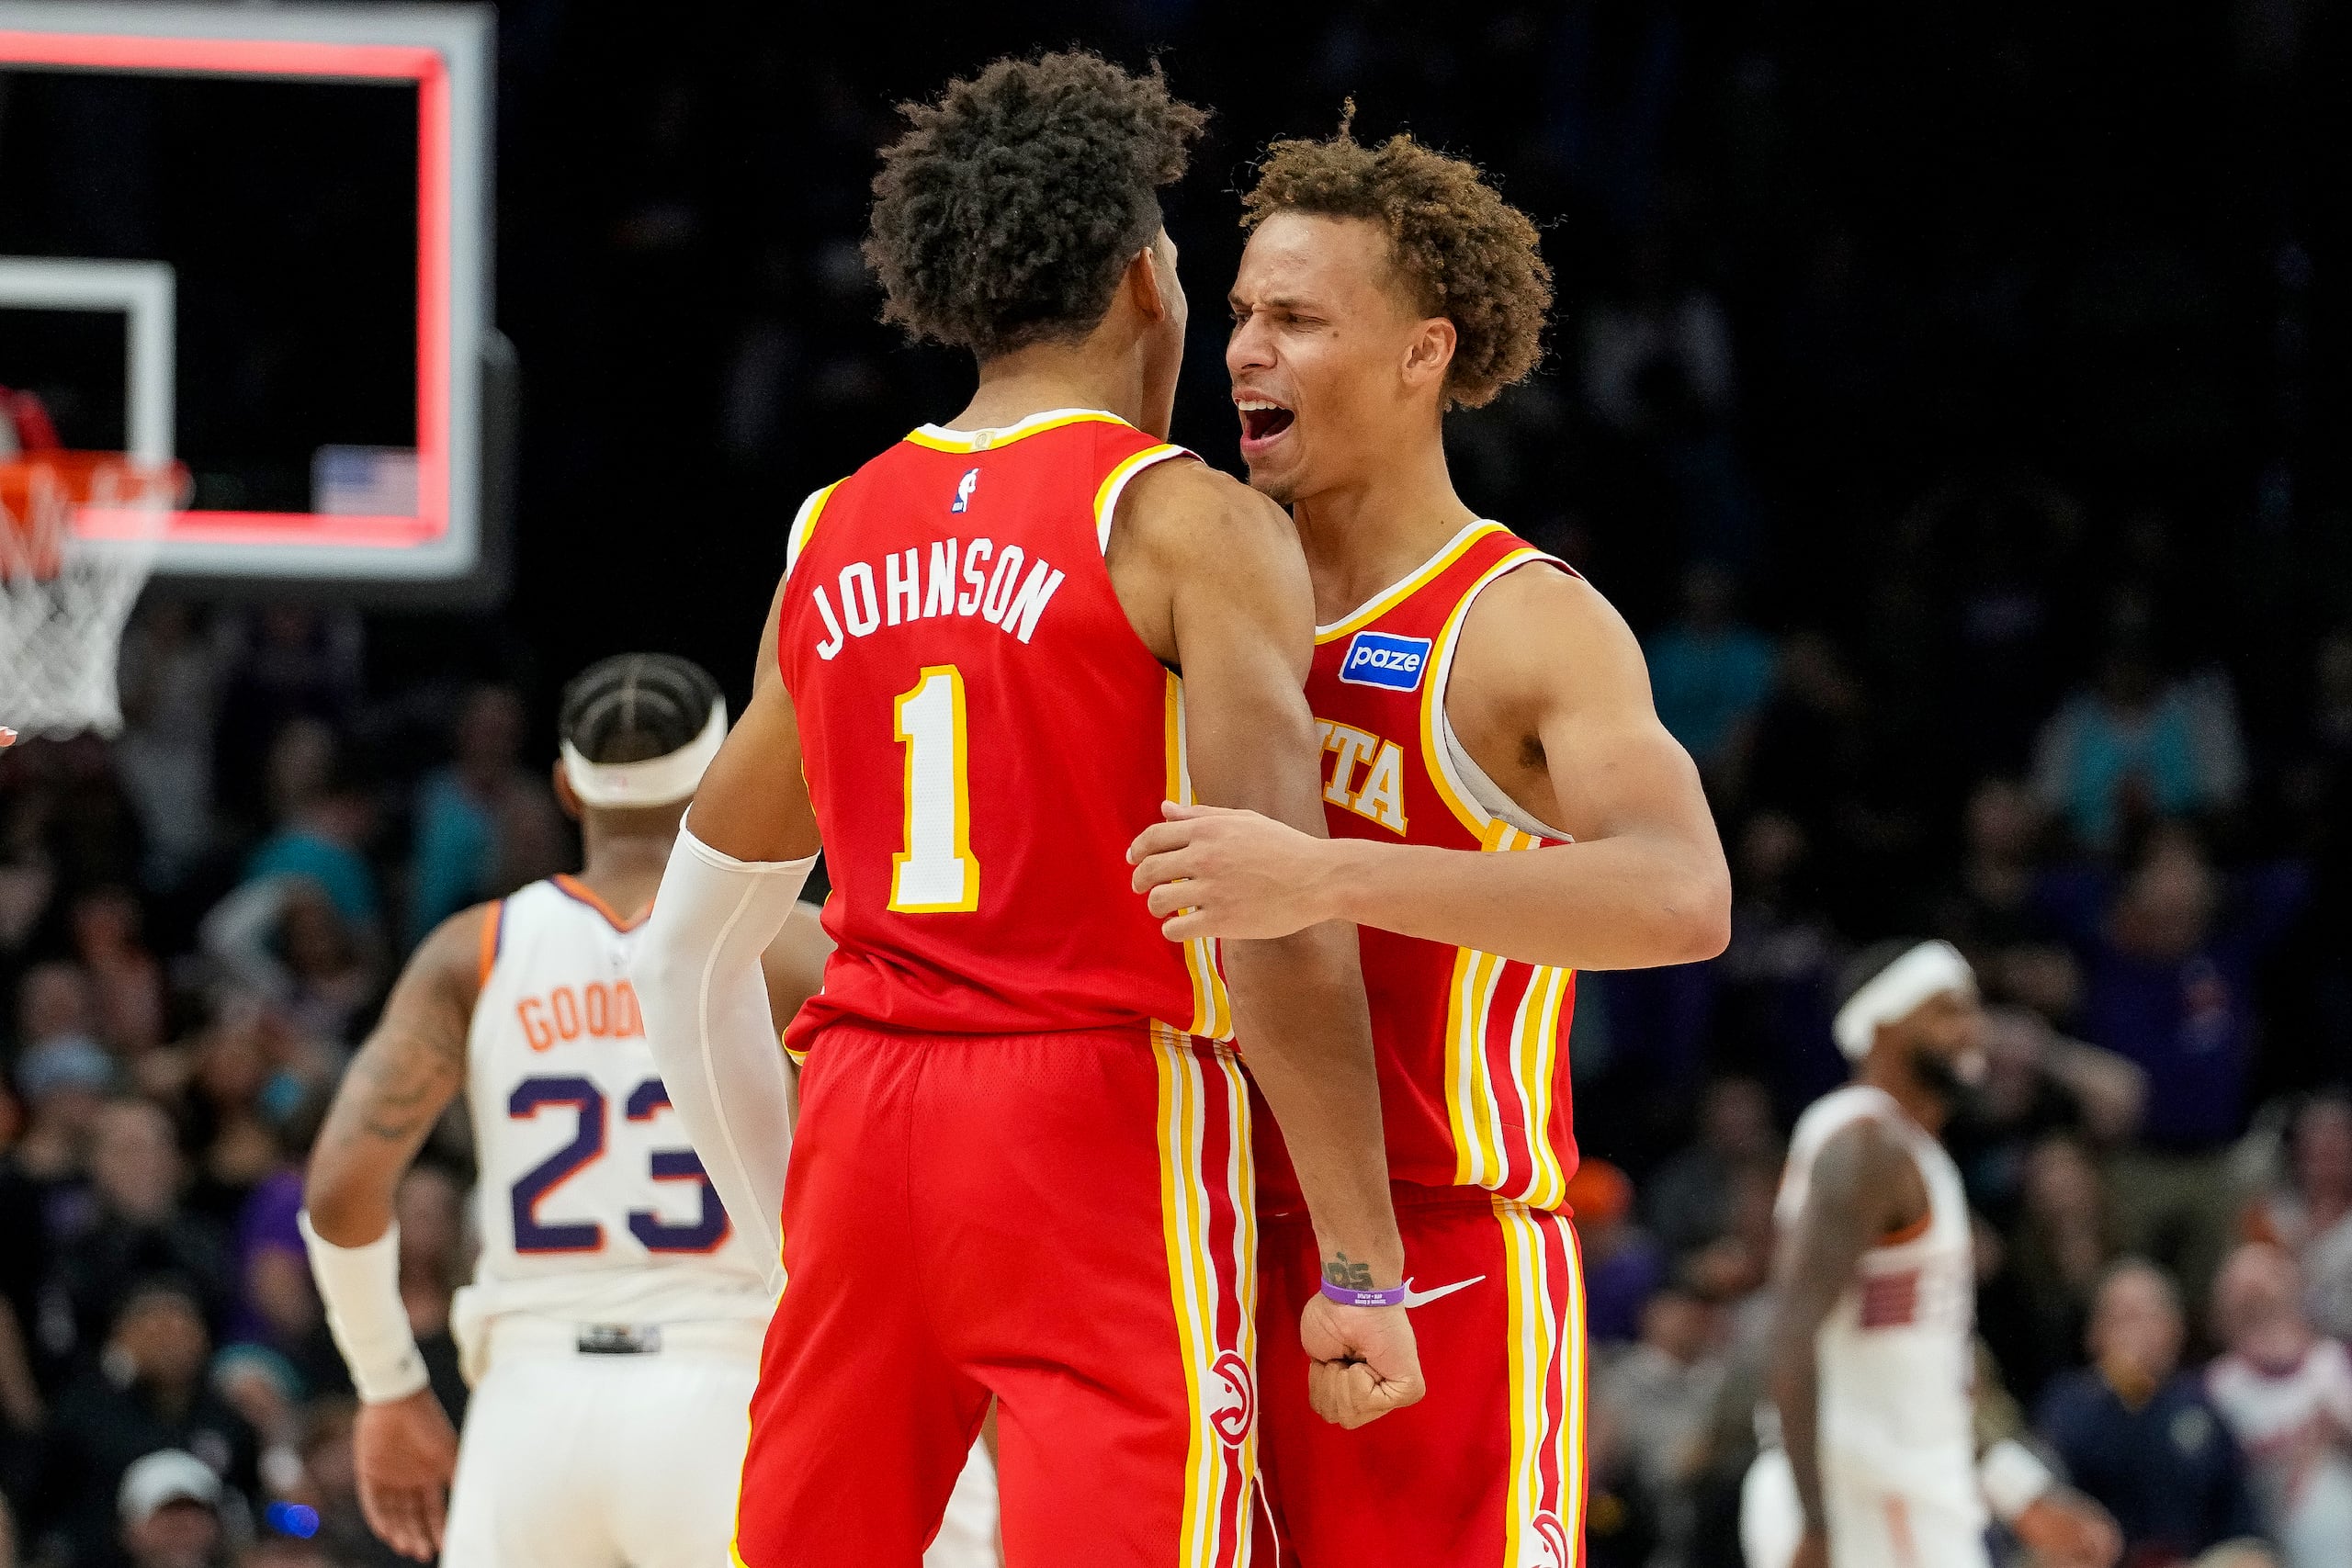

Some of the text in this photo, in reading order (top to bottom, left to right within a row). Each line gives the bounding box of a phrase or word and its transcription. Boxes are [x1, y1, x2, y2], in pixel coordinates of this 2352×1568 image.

[813, 537, 1066, 660] JOHNSON
[1351, 646, 1420, 672] paze
[887, 664, 980, 913] 1
[508, 1075, 735, 1256] 23
